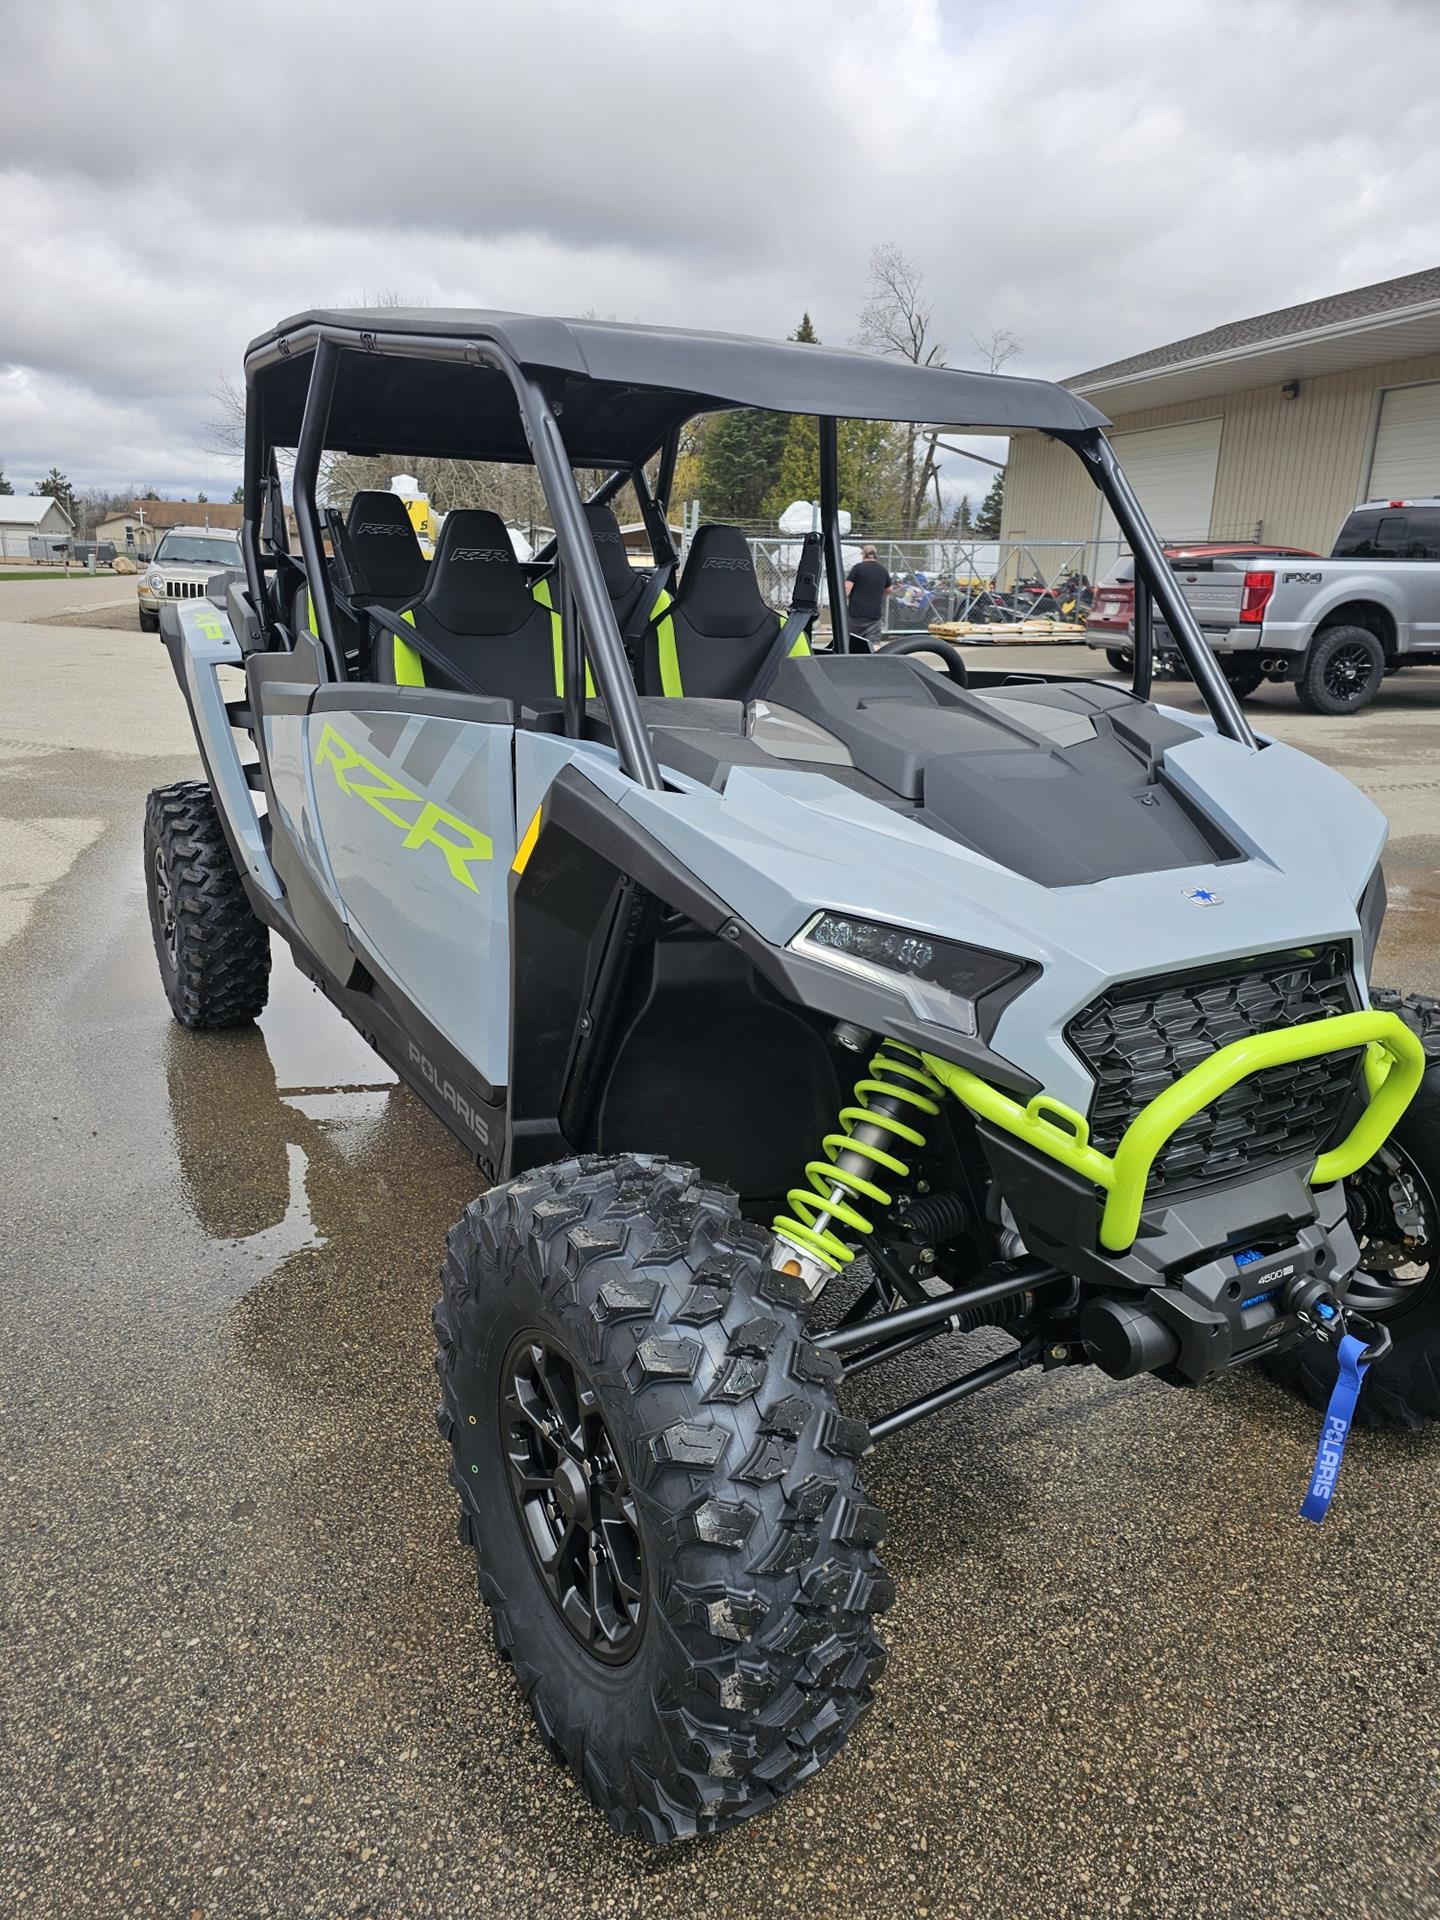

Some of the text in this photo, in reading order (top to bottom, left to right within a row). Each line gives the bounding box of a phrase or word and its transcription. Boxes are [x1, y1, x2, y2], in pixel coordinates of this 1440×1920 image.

[357, 522, 409, 536] RZR
[450, 547, 509, 562] RZR
[702, 556, 751, 571] RZR
[1281, 572, 1323, 585] FX4
[192, 610, 225, 640] XP
[314, 720, 495, 895] RZR
[408, 1039, 489, 1147] POLARIS
[1258, 1269, 1283, 1285] 4500
[1312, 1415, 1347, 1500] POLARIS
